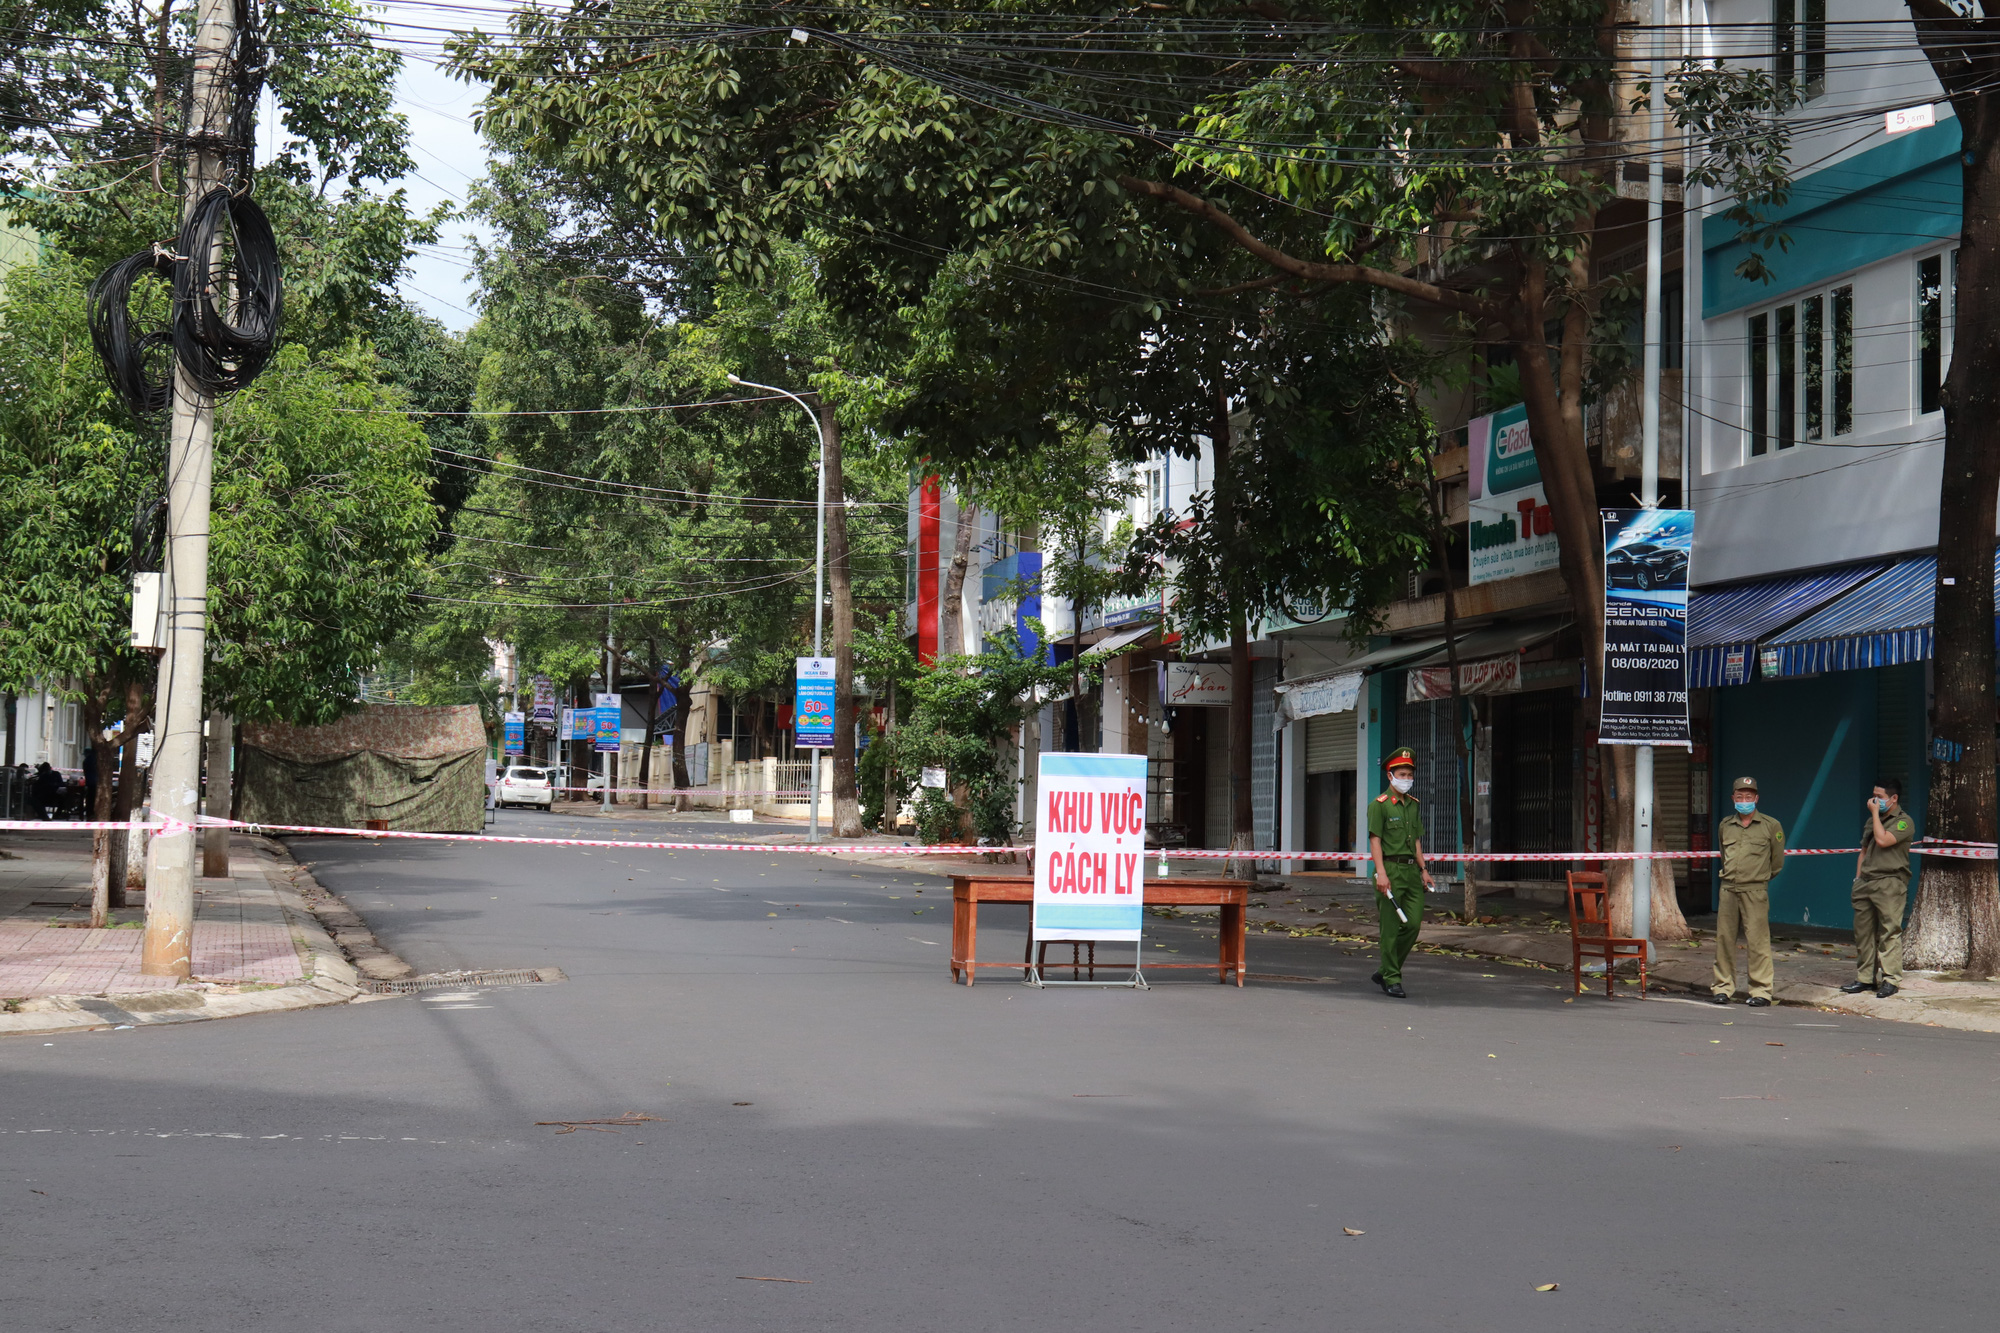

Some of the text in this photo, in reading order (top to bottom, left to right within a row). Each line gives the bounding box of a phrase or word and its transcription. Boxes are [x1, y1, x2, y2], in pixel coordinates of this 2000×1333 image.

[1470, 512, 1517, 553] Honda
[1513, 546, 1525, 559] mua
[1605, 643, 1618, 652] RA
[1643, 643, 1657, 654] TẠI
[1659, 643, 1674, 654] ĐẠI
[1611, 657, 1679, 670] 08/08/2020
[1603, 690, 1688, 703] Hotline 0911 38 7799
[1586, 743, 1600, 853] MOTUL
[1048, 786, 1143, 844] KHU VỰC
[1048, 842, 1137, 895] CÁCH LY
